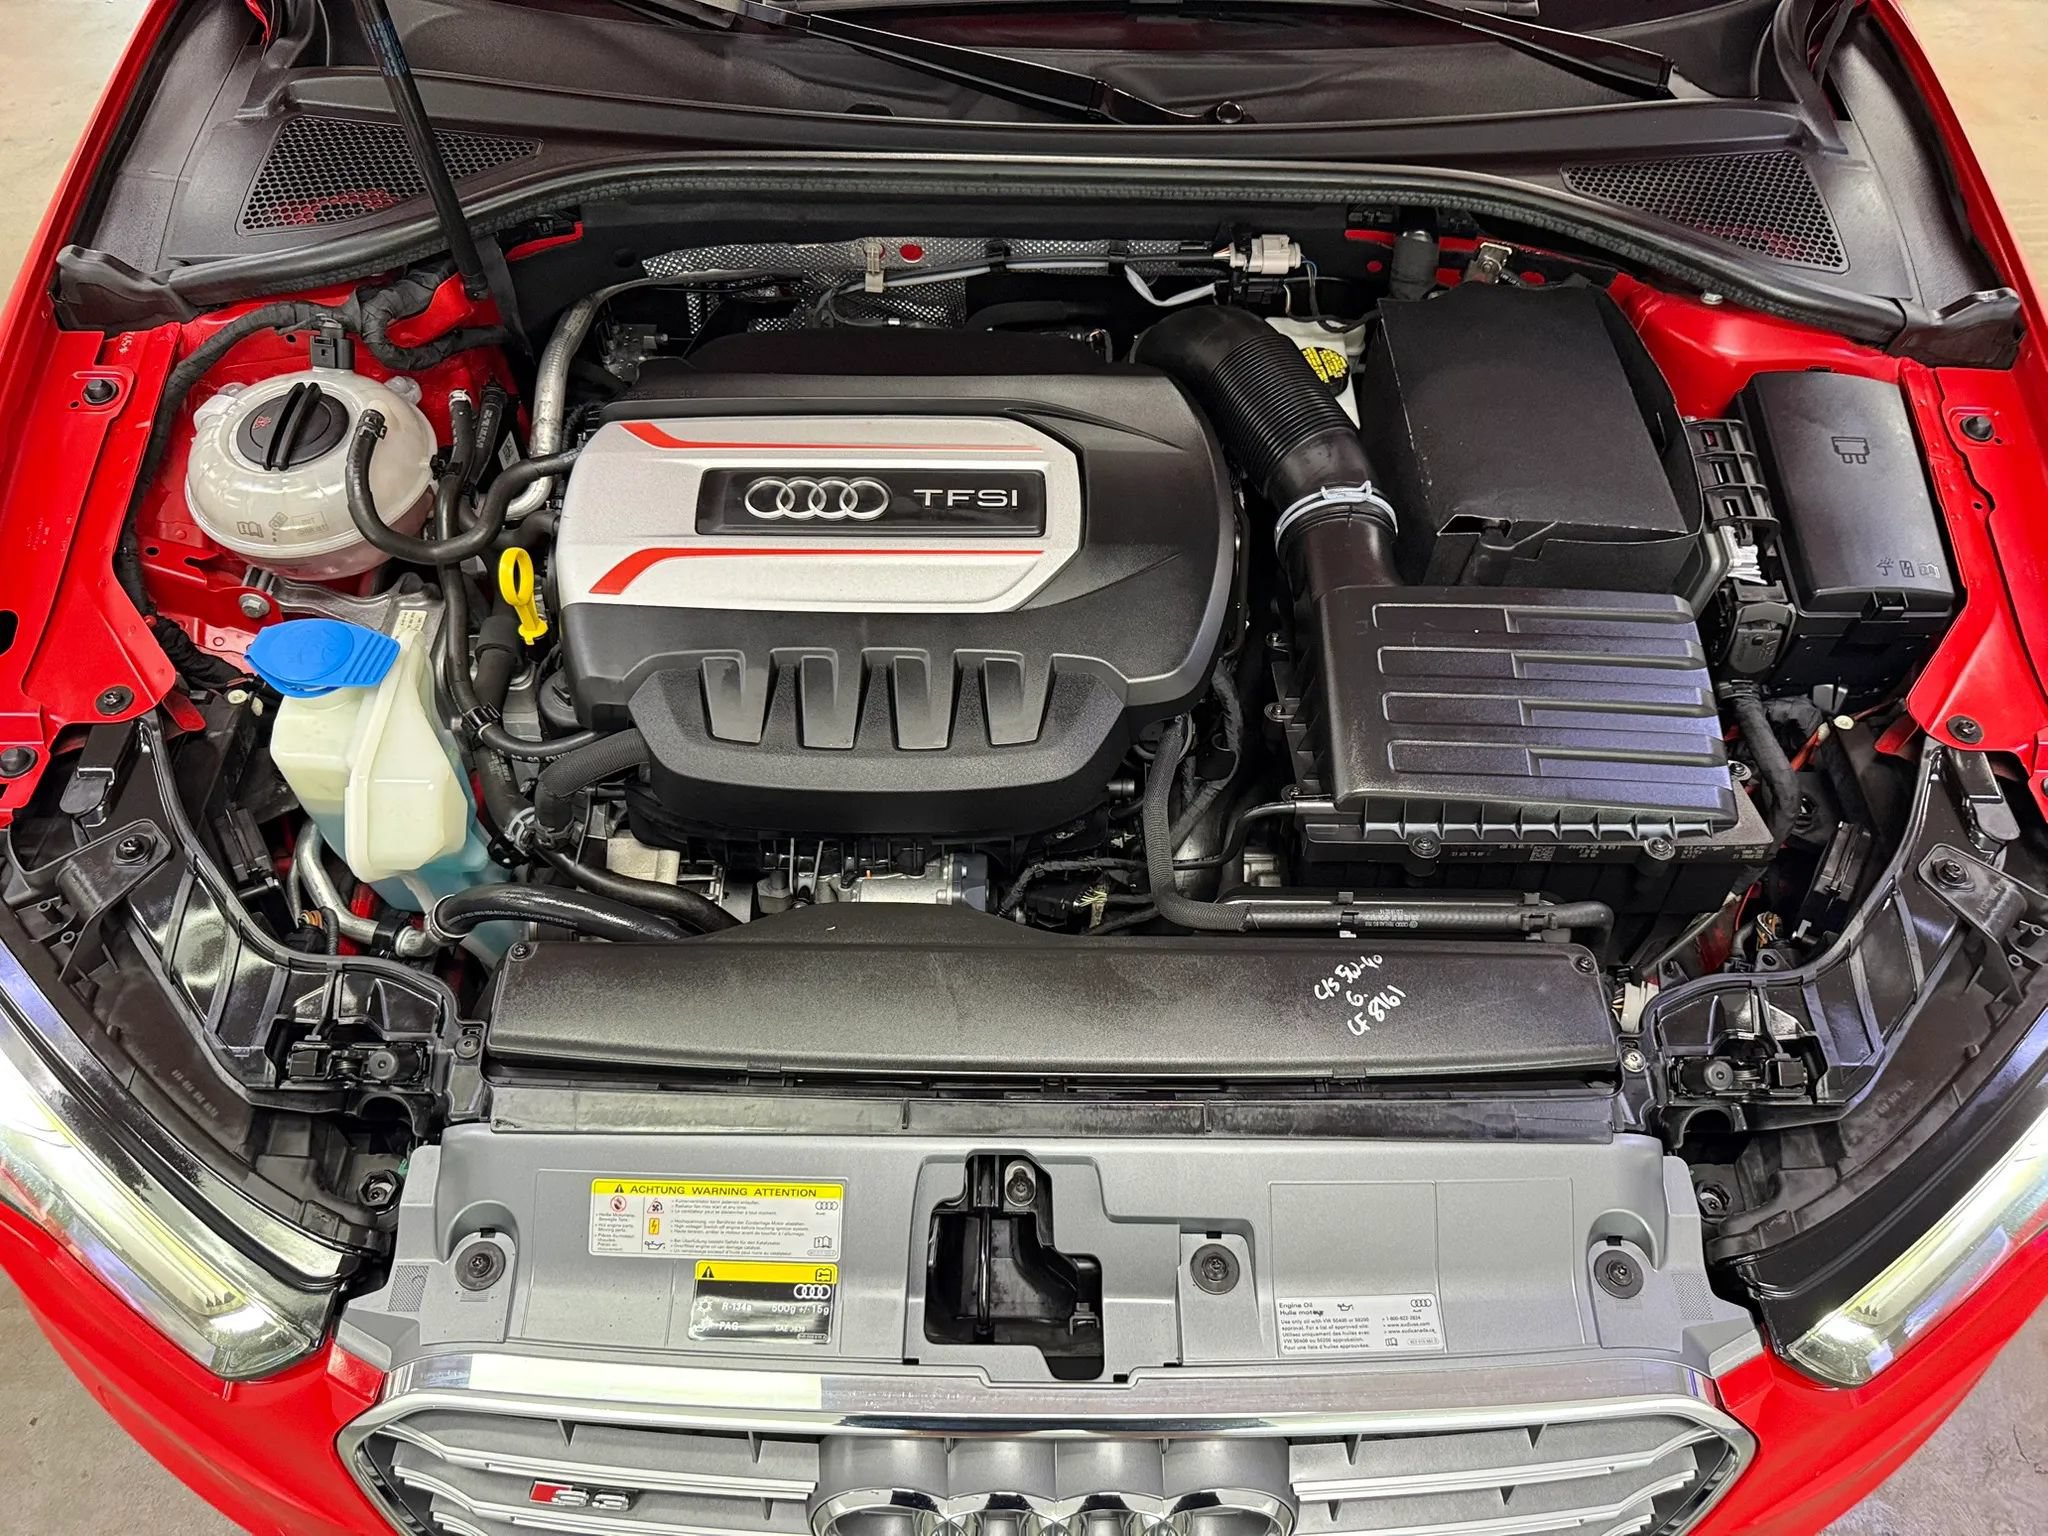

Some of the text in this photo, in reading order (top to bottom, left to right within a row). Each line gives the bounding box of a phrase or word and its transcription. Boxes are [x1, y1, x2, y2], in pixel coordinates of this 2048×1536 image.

[913, 489, 1018, 507] TFSI
[630, 1185, 817, 1198] ACHTUNG WARNING ATTENTION
[718, 1321, 739, 1332] PAG
[549, 1486, 631, 1512] S3
